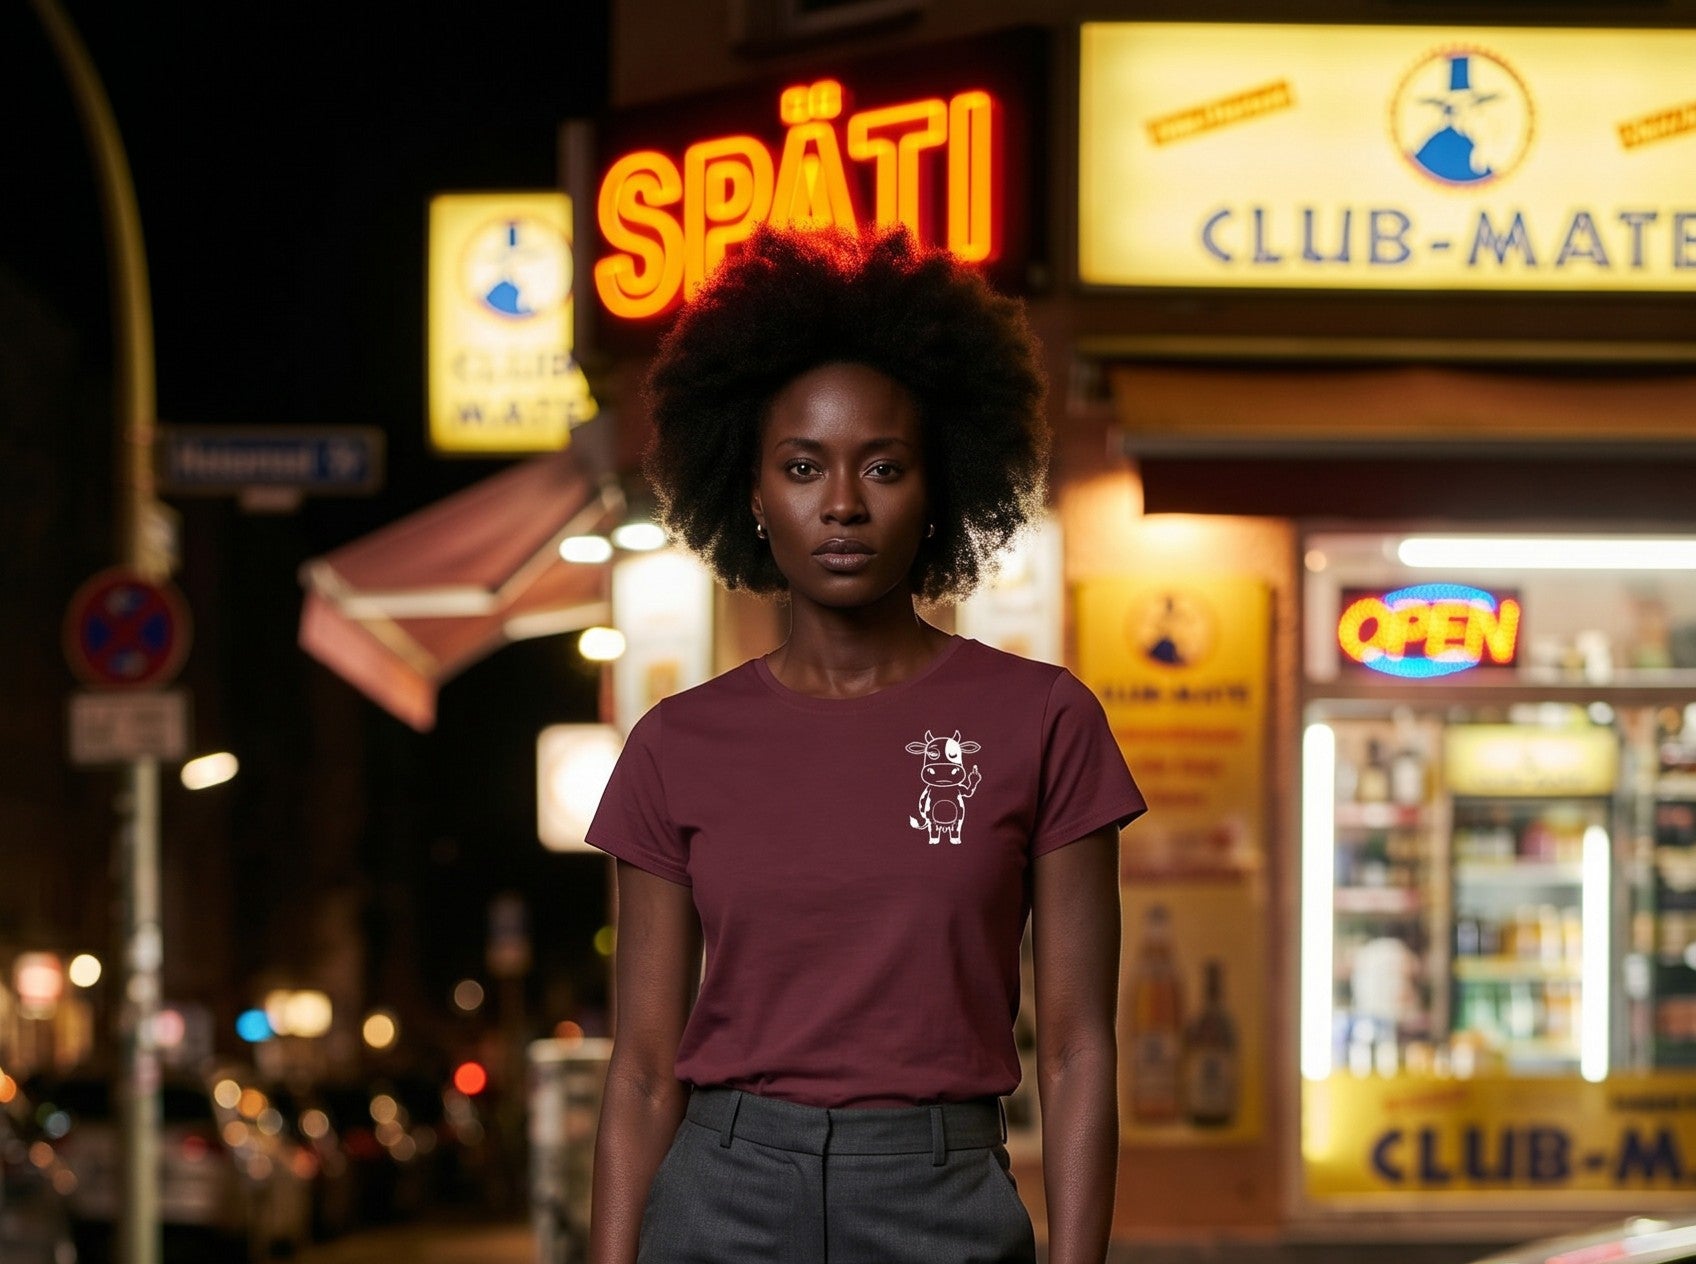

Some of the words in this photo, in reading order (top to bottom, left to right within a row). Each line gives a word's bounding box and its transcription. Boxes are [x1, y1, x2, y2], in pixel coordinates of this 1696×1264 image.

[594, 79, 993, 319] SPÄTI
[1201, 208, 1696, 268] CLUB-MATE
[1338, 597, 1520, 664] OPEN
